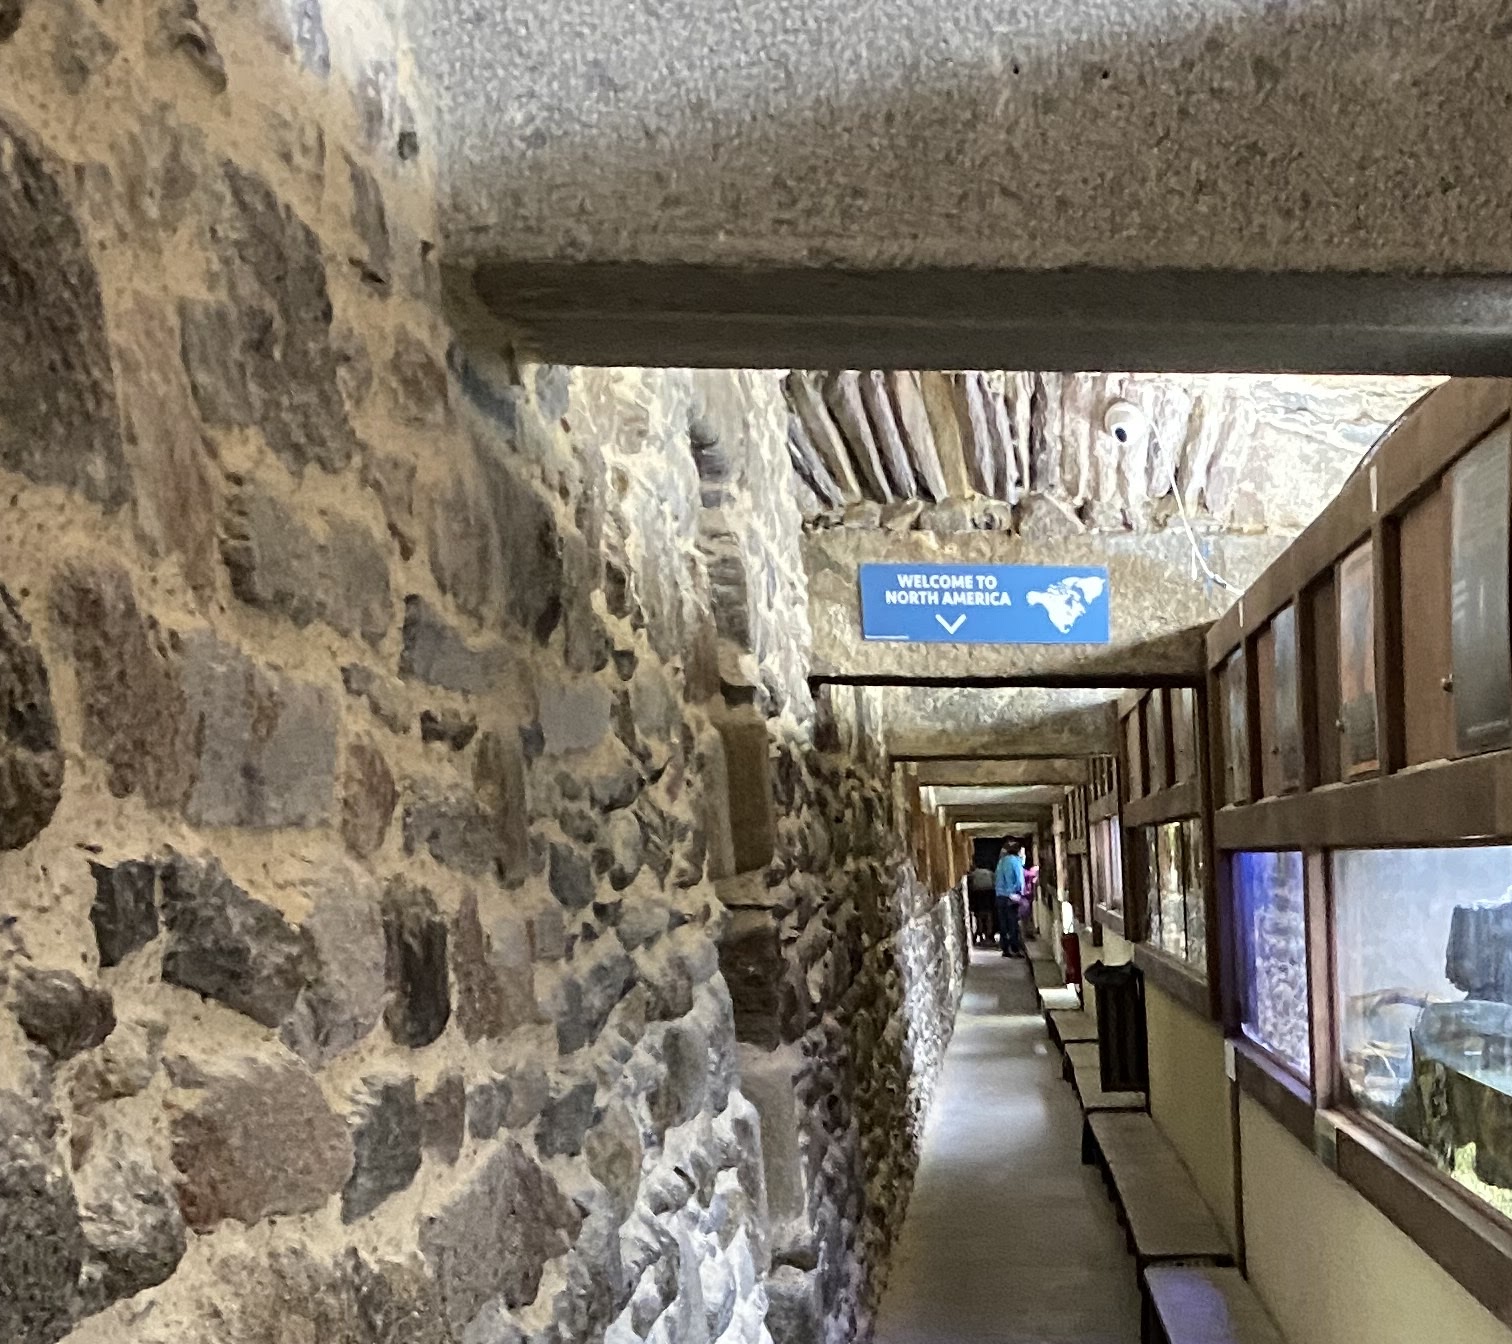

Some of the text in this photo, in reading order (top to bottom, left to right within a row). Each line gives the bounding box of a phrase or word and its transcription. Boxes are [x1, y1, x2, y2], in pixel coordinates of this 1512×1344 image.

[897, 574, 998, 589] WELCOME TO
[885, 590, 1012, 606] NORTH AMERICA
